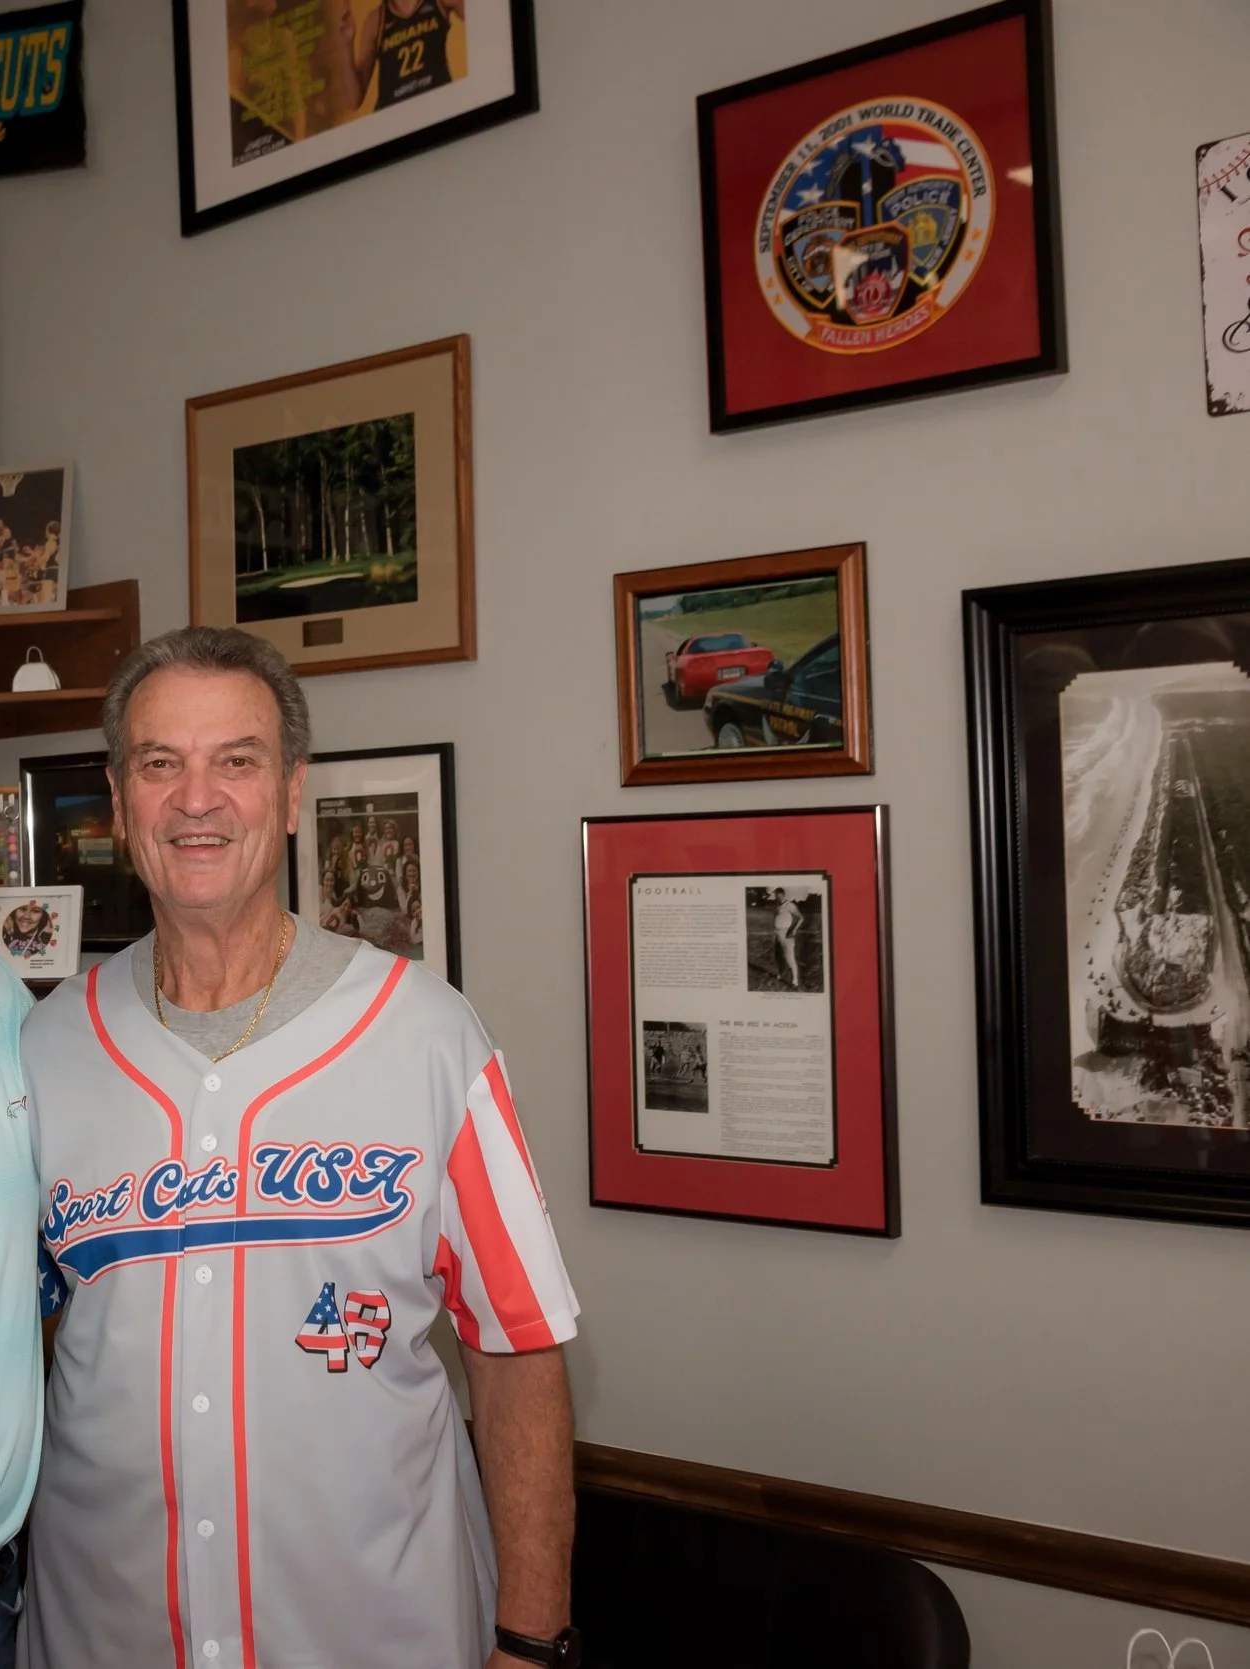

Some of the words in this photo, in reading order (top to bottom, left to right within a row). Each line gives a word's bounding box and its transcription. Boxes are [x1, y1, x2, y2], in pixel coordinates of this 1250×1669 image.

[397, 38, 425, 78] 22
[760, 161, 797, 253] SEPTEMBER
[819, 114, 852, 141] 2001
[858, 103, 914, 121] WORLD
[917, 106, 962, 141] TRADE
[957, 138, 987, 199] CENTER
[821, 327, 871, 345] FALLEN
[874, 304, 930, 343] HEROES
[638, 887, 702, 895] FOOTBALL
[43, 1174, 134, 1245] Sport
[138, 1157, 240, 1223] Cuts
[251, 1141, 424, 1212] USA
[294, 1281, 392, 1373] 48
